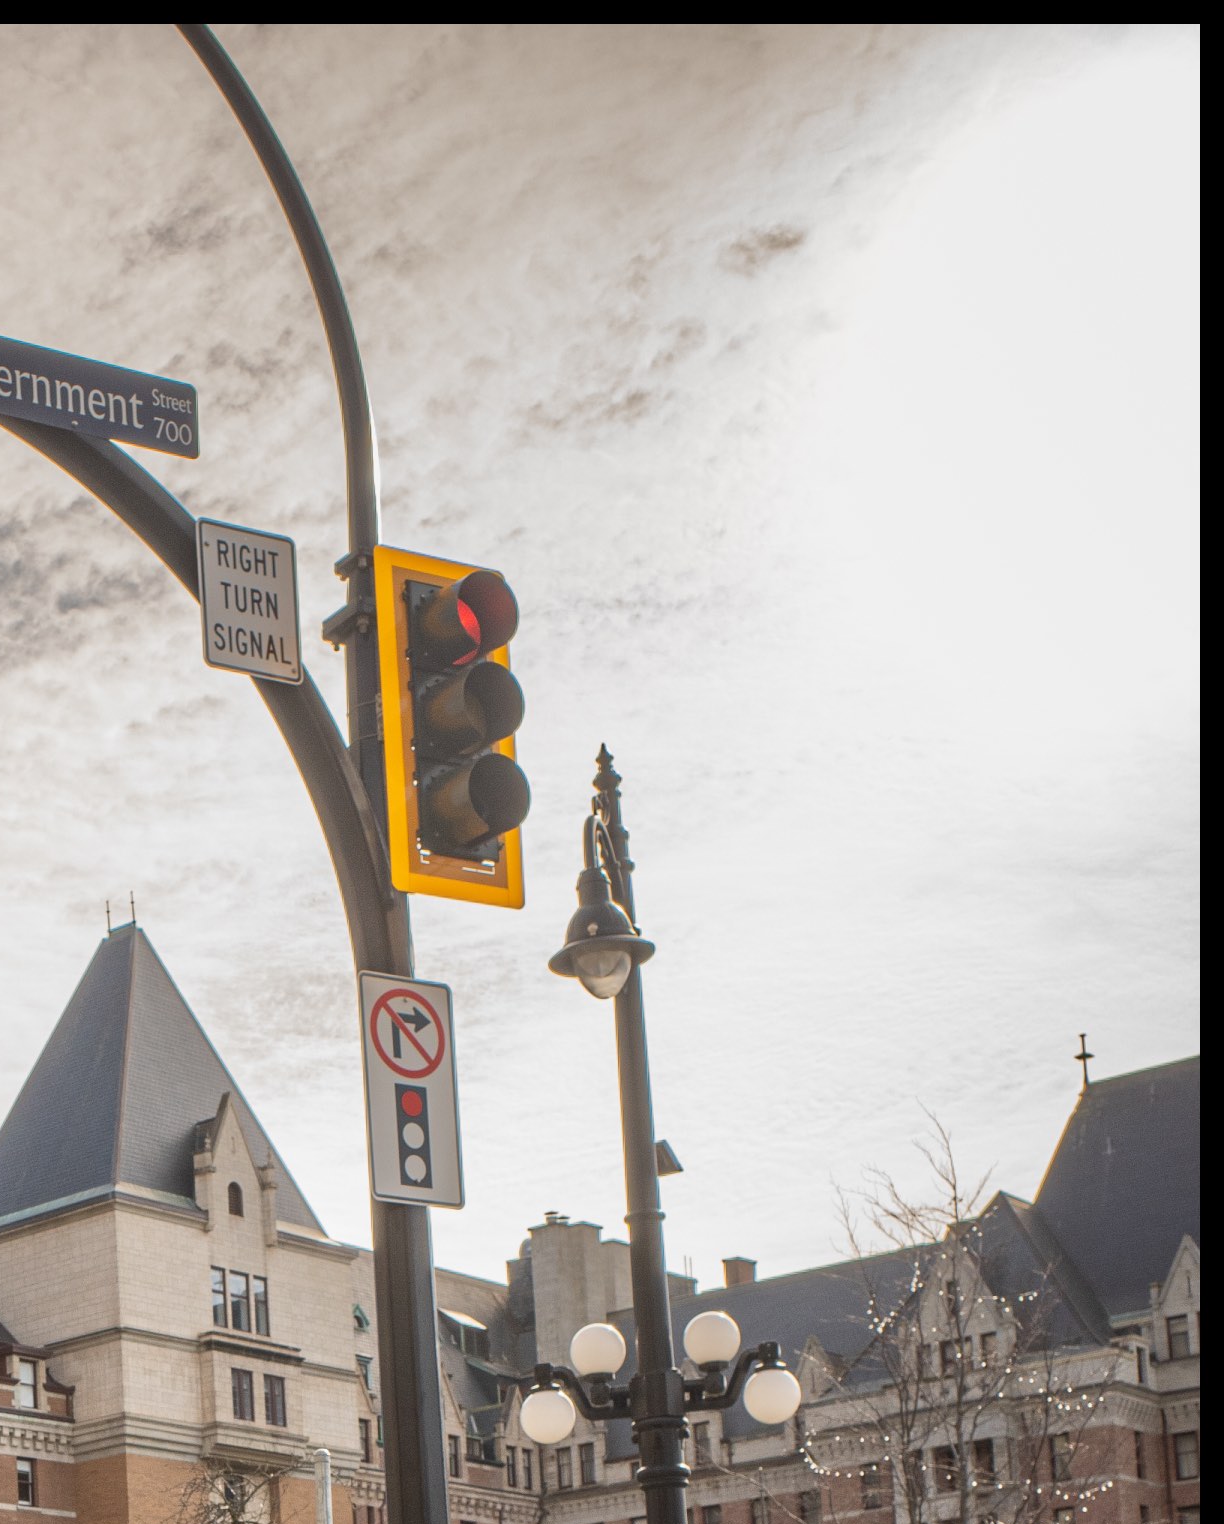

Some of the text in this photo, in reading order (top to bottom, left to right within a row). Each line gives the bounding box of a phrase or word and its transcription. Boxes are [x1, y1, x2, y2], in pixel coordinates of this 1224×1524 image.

[151, 388, 192, 415] Street
[153, 416, 192, 445] 700
[216, 539, 279, 579] RIGHT
[220, 581, 279, 620] TURN
[213, 622, 292, 665] SIGNAL
